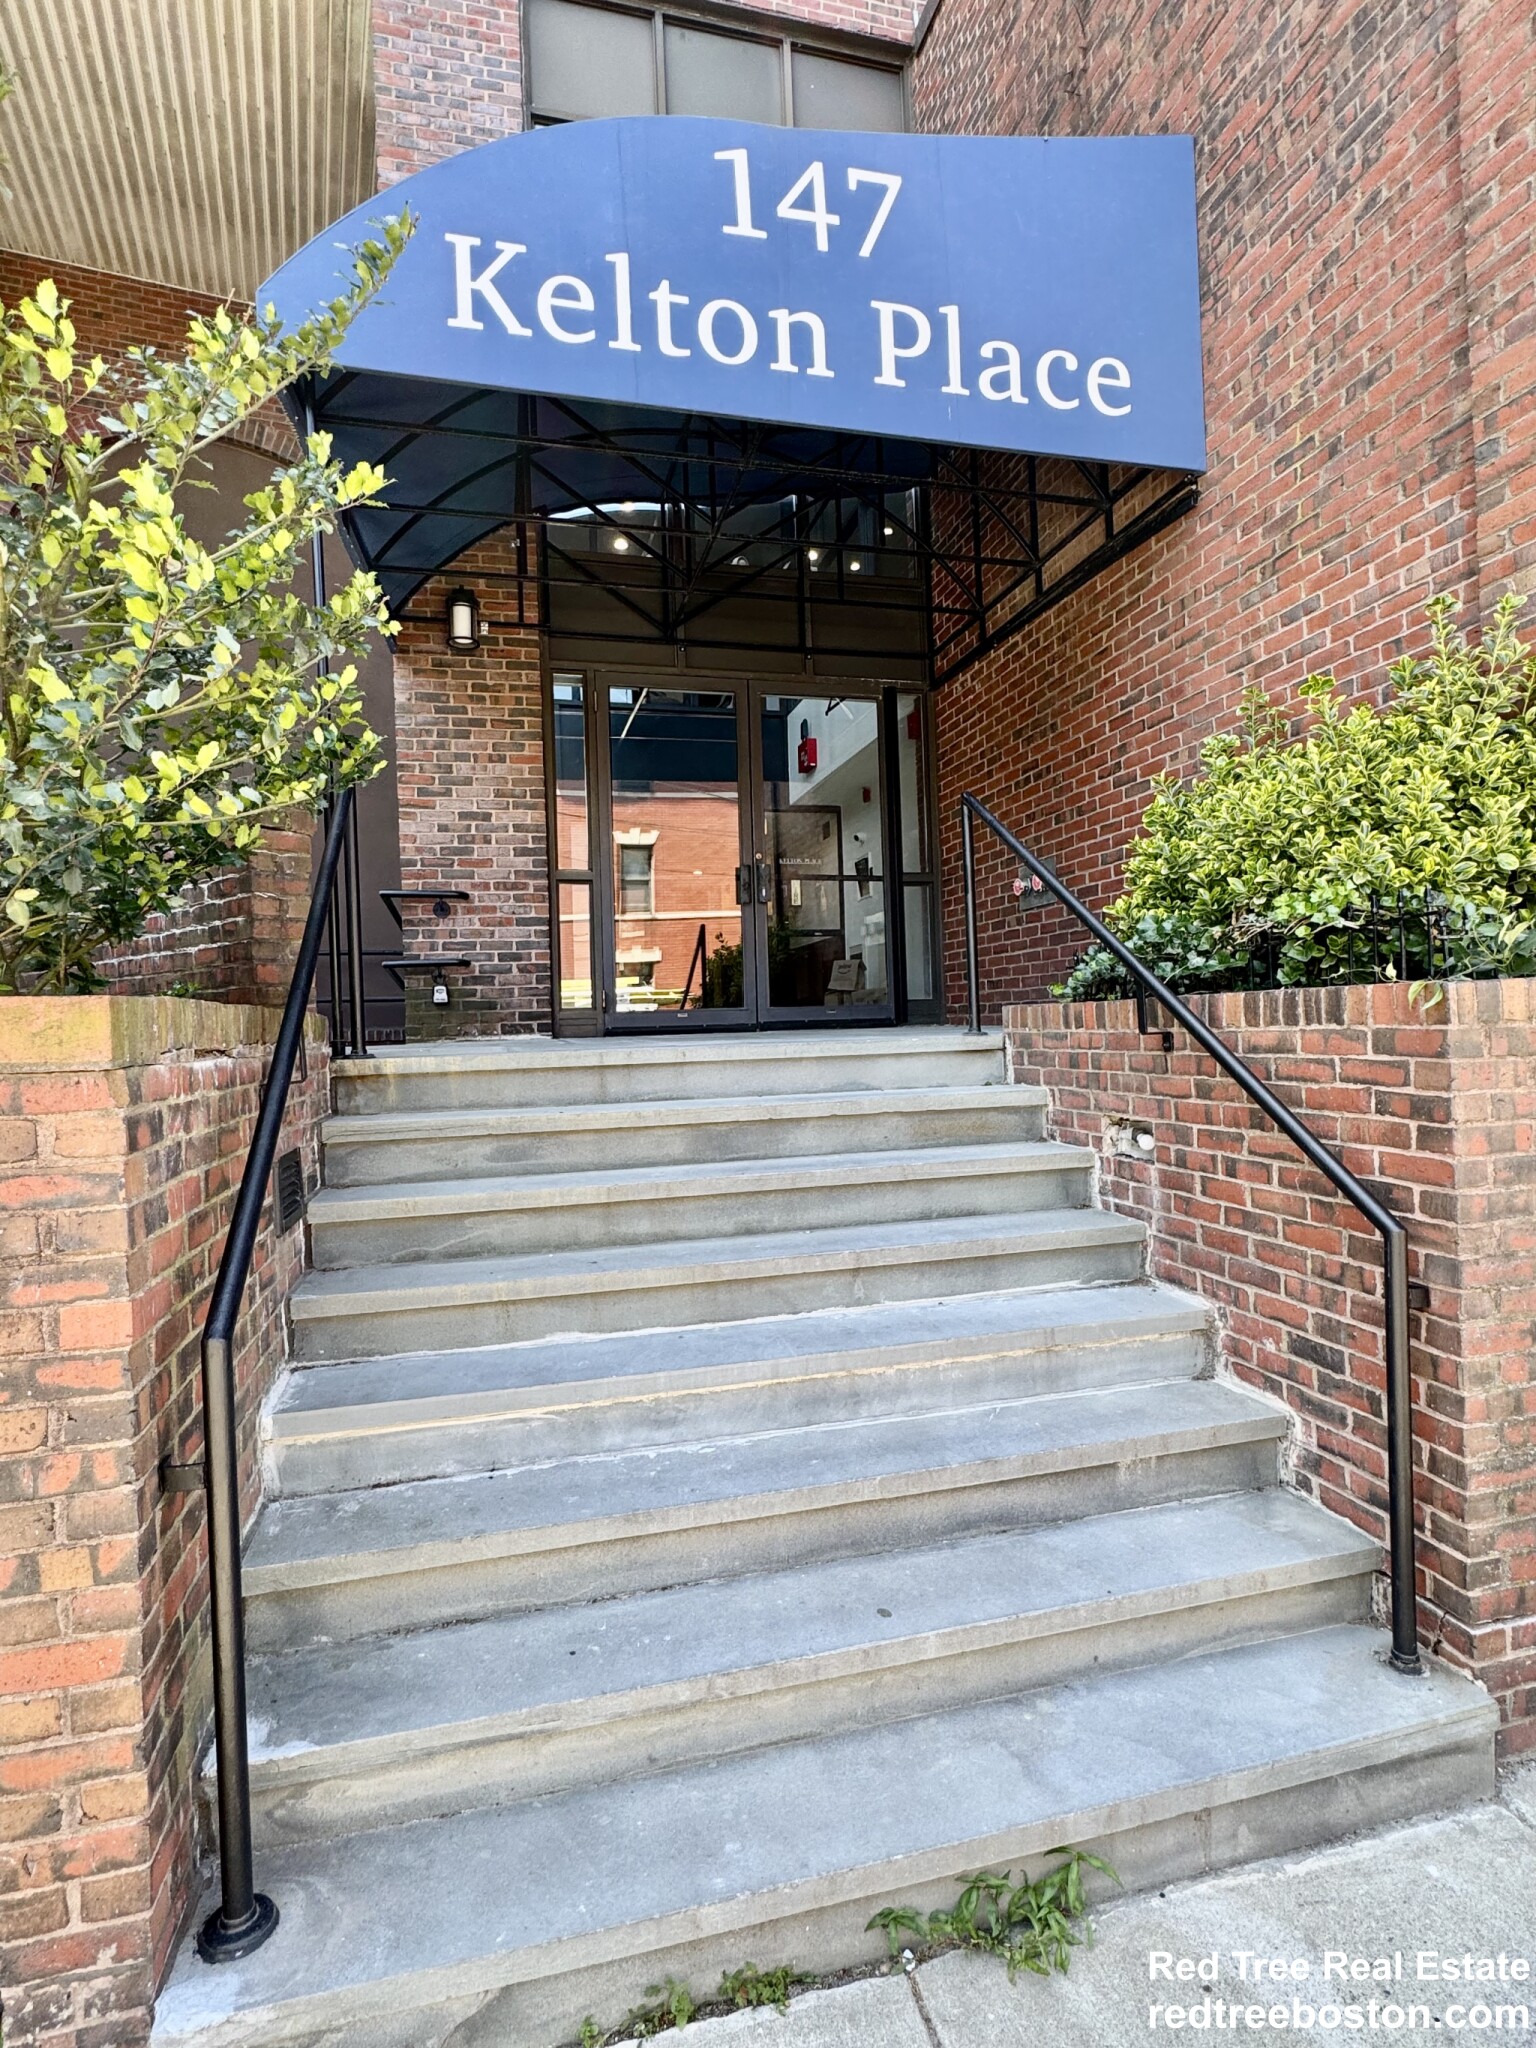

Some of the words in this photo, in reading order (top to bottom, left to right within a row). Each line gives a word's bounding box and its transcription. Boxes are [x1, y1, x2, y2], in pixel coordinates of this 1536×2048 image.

[713, 148, 902, 258] 147
[444, 232, 835, 378] Kelton
[870, 300, 1132, 417] Place
